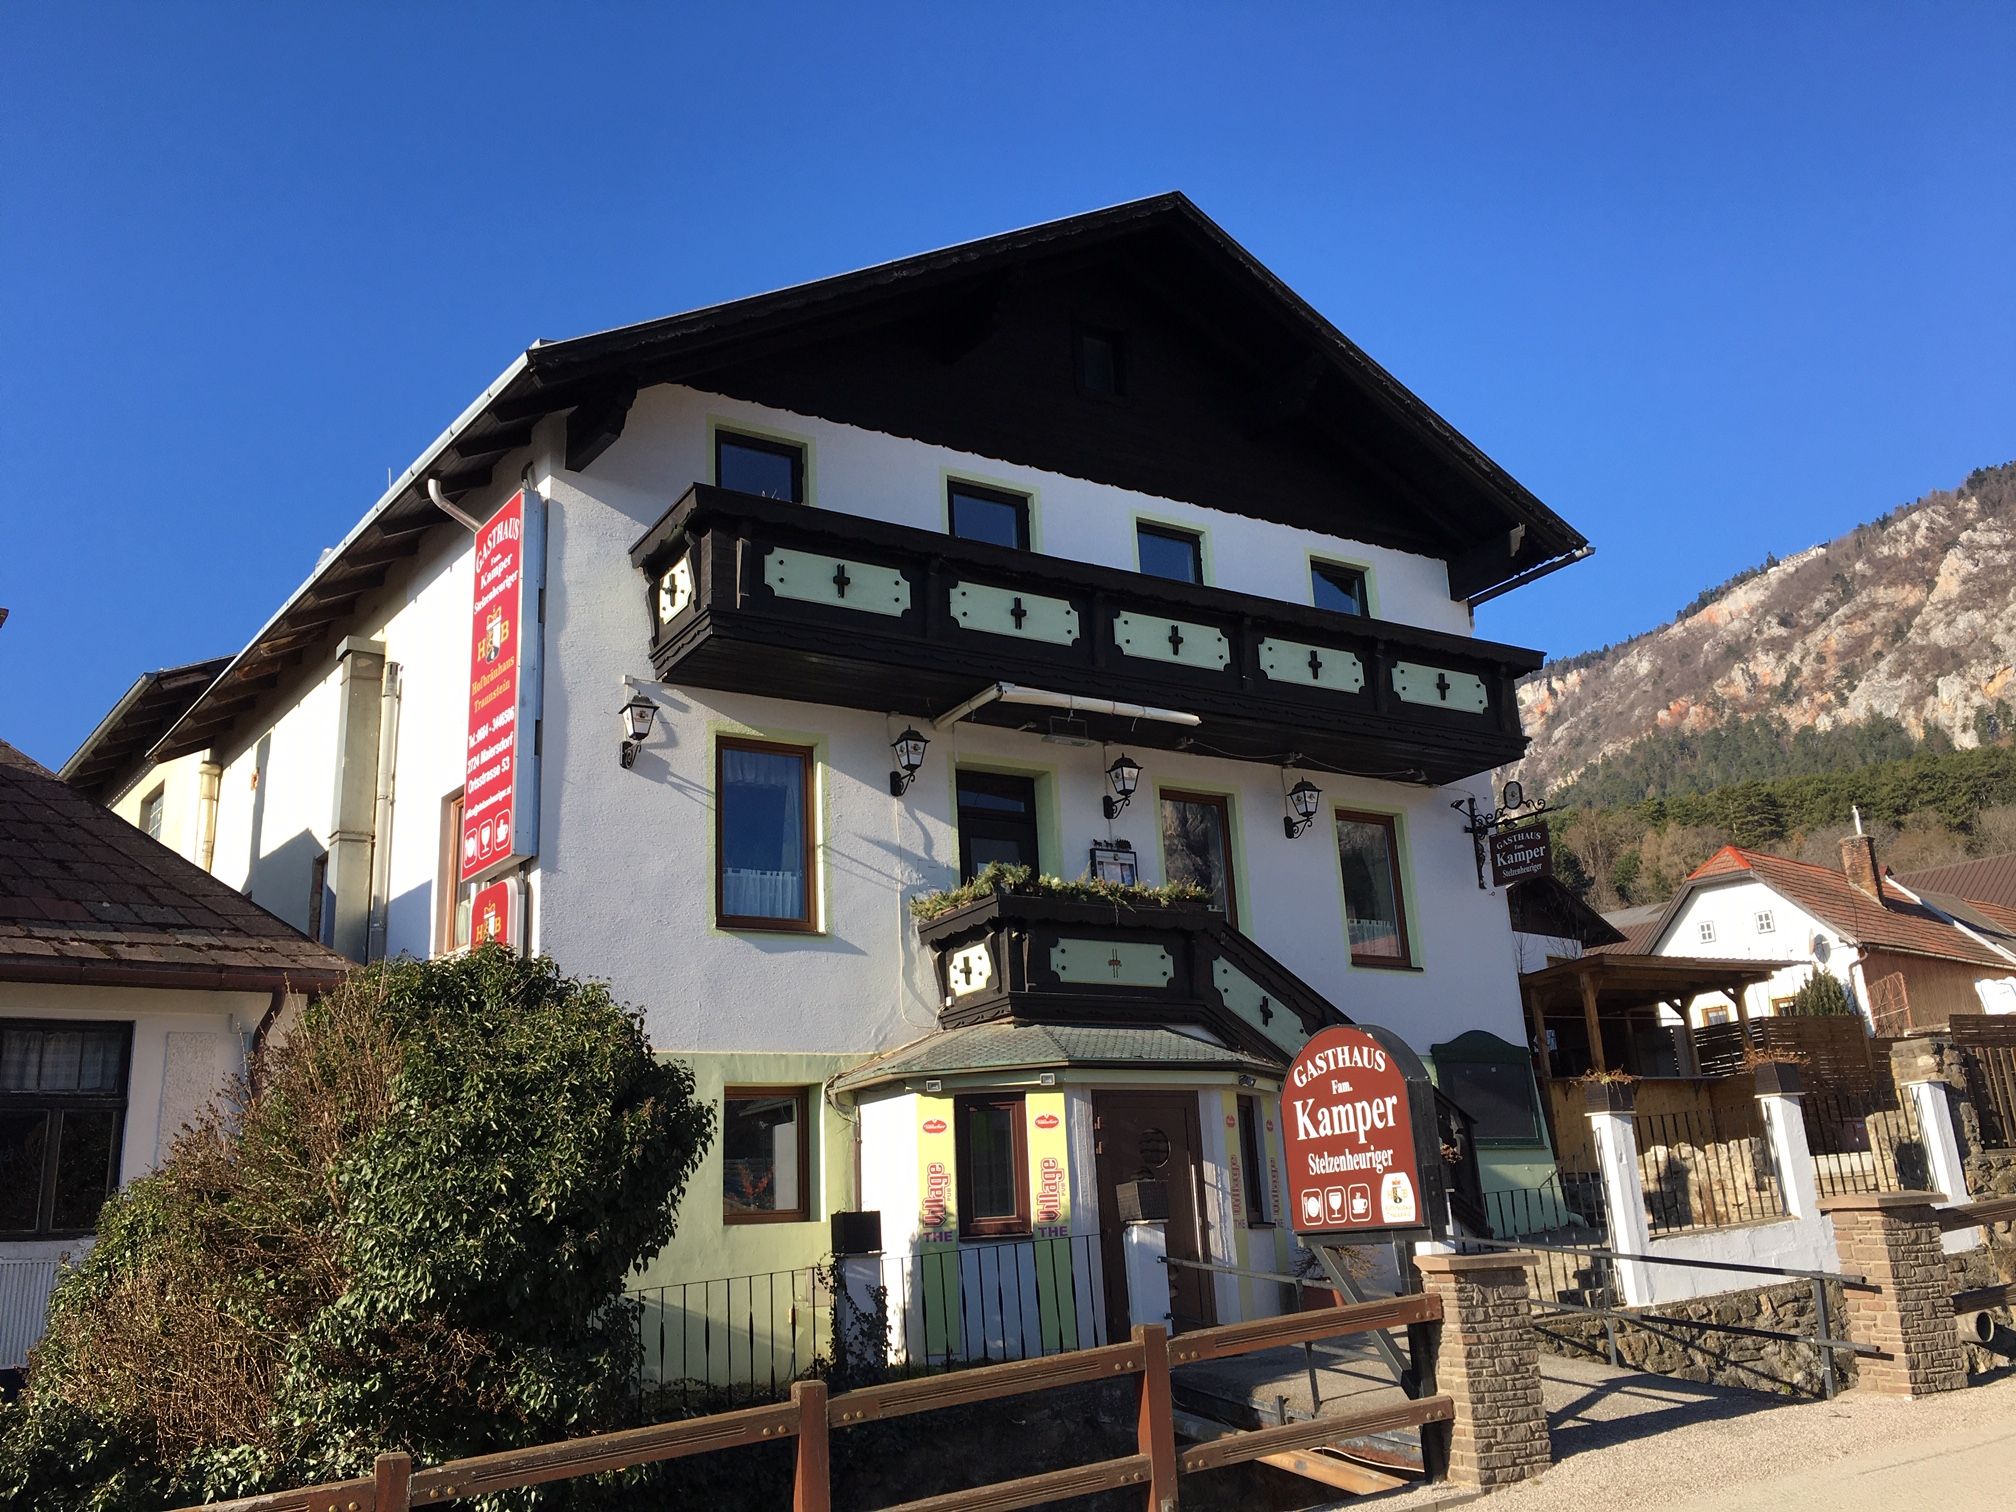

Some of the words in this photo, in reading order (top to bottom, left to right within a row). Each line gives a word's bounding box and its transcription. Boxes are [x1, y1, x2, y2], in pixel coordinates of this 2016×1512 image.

[476, 517, 520, 574] GASTHAUS
[480, 553, 512, 590] Kamper
[472, 656, 514, 696] Hofbräuhaus
[474, 679, 510, 713] Traunstein
[480, 731, 514, 765] Maiersdorf
[501, 755, 510, 772] 53
[1496, 832, 1542, 850] GASTHAUS
[1496, 845, 1546, 867] Kamper
[1502, 862, 1542, 878] Stelzenheuriger
[1293, 1045, 1386, 1088] GASTHAUS
[1331, 1080, 1353, 1094] Fam.
[1292, 1095, 1398, 1144] Kamper
[1308, 1145, 1393, 1176] Stelzenheuriger
[922, 1162, 951, 1229] Village
[1037, 1157, 1064, 1224] Village
[924, 1231, 953, 1243] THE
[1038, 1226, 1068, 1238] THE
[1234, 1218, 1246, 1229] THE
